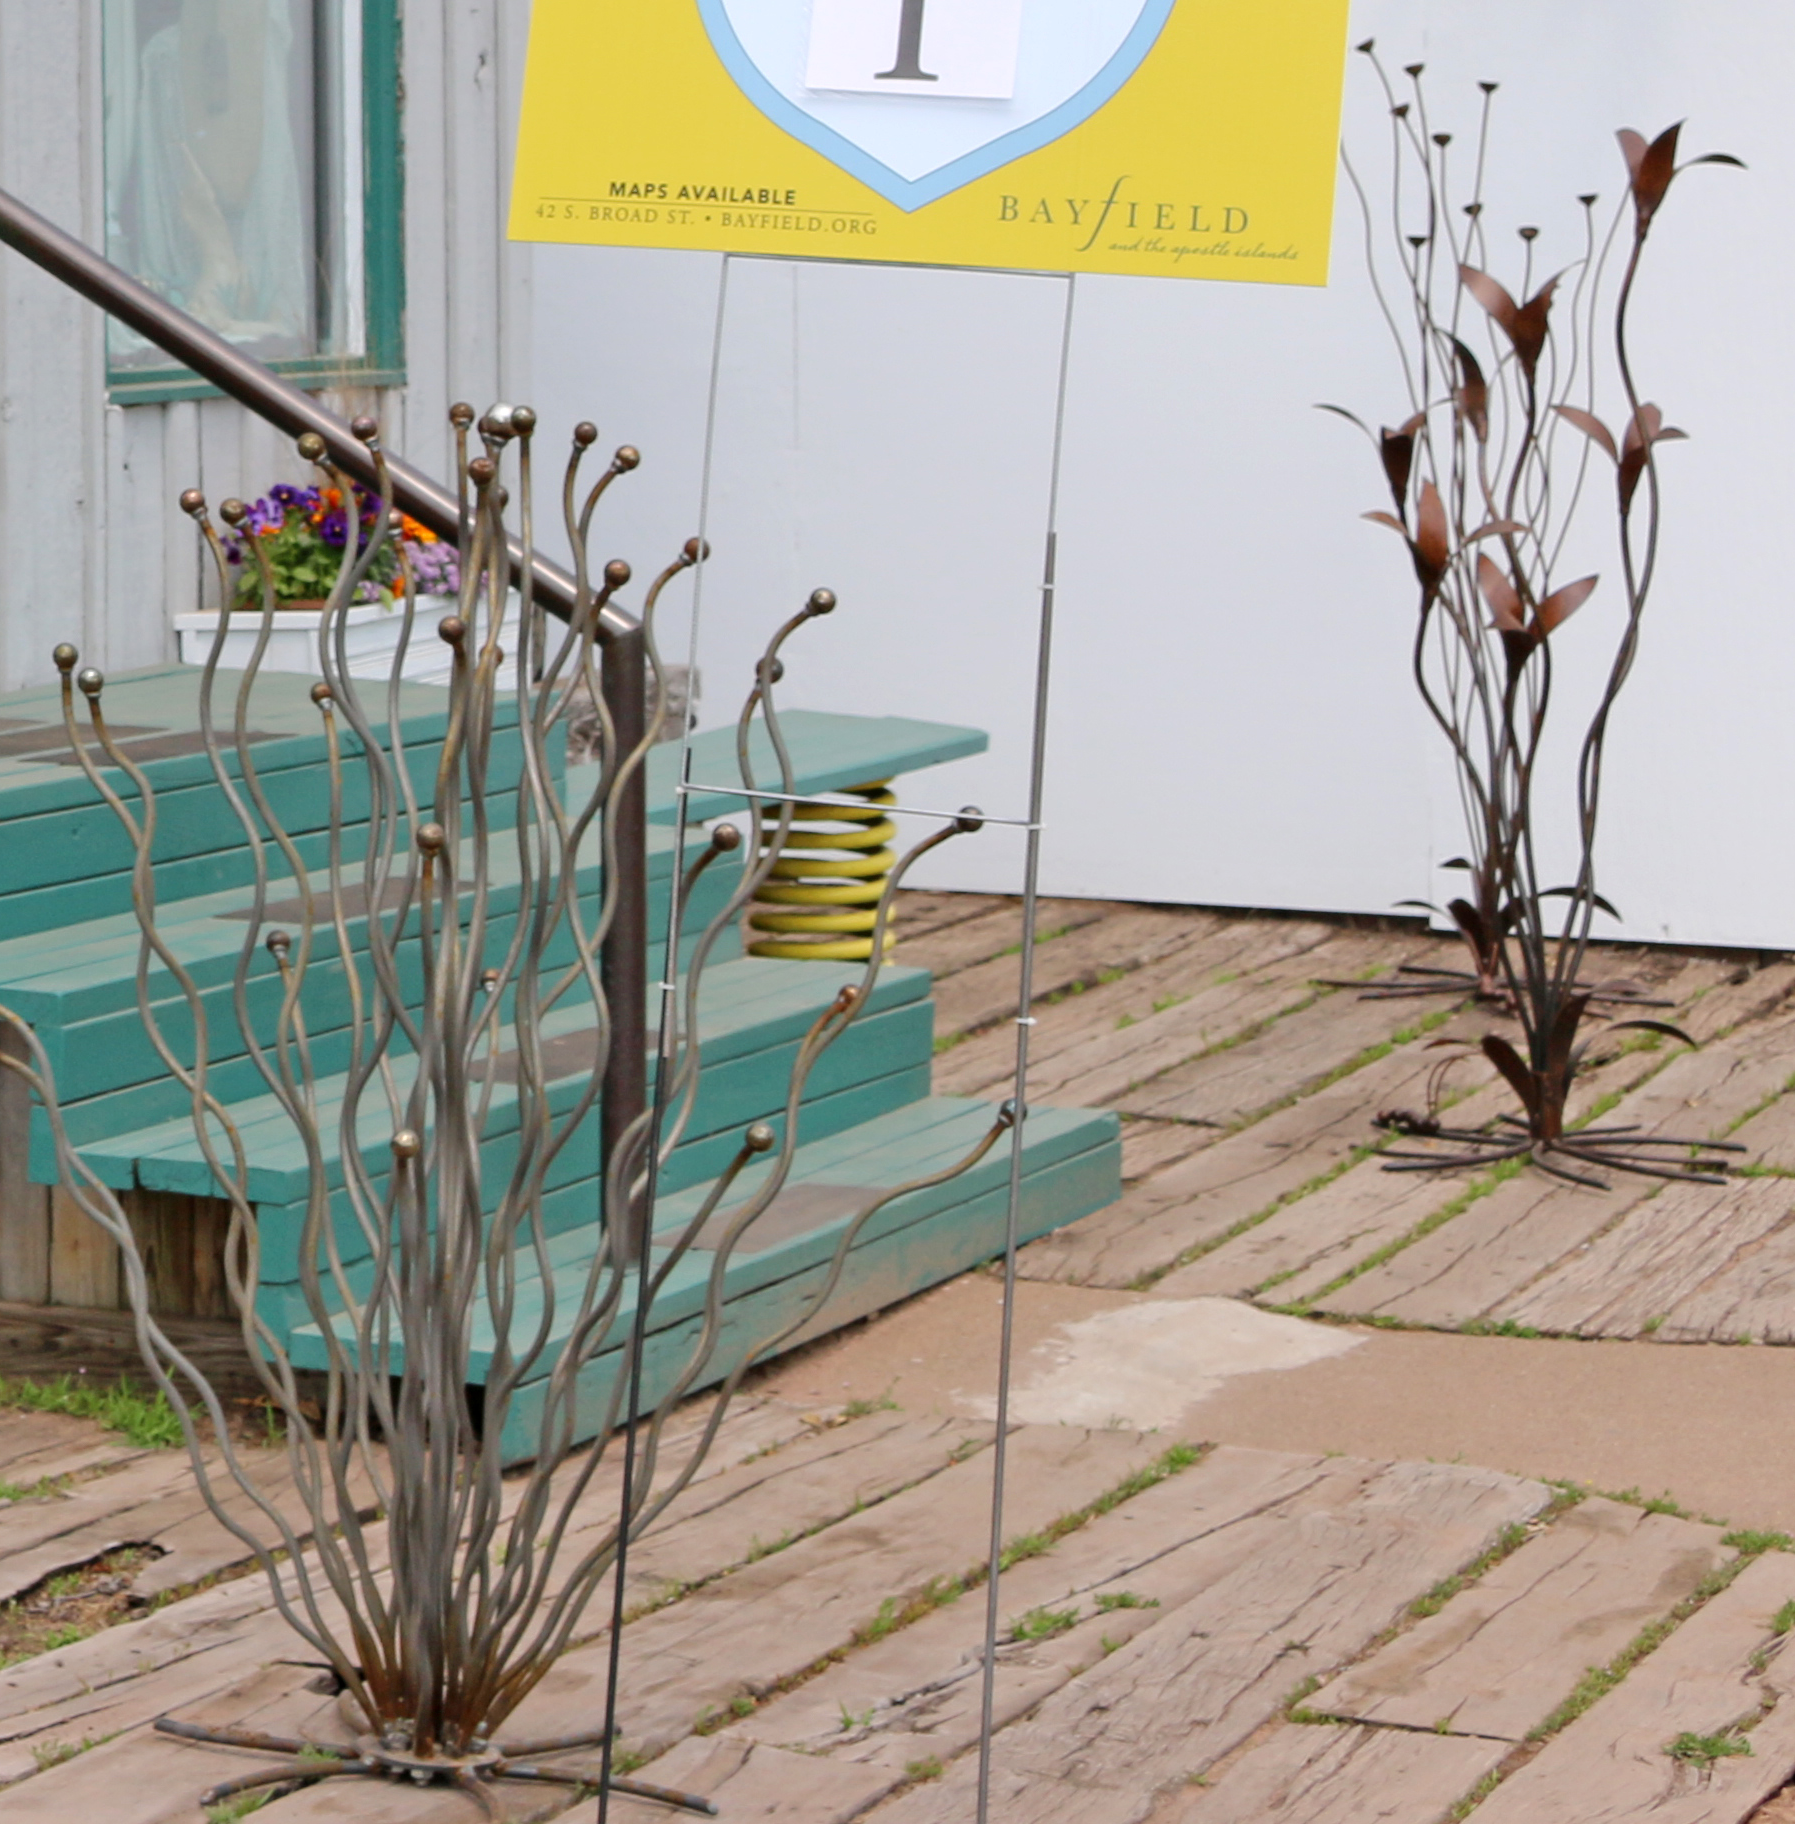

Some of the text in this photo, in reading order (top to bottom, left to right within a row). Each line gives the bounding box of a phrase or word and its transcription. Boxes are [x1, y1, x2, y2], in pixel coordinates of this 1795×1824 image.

[609, 181, 797, 206] MAPS AVAILABLE
[535, 203, 878, 236] 42 S. BROAD ST. BAYFIELD.ORG
[1108, 237, 1299, 264] and the apostle islands
